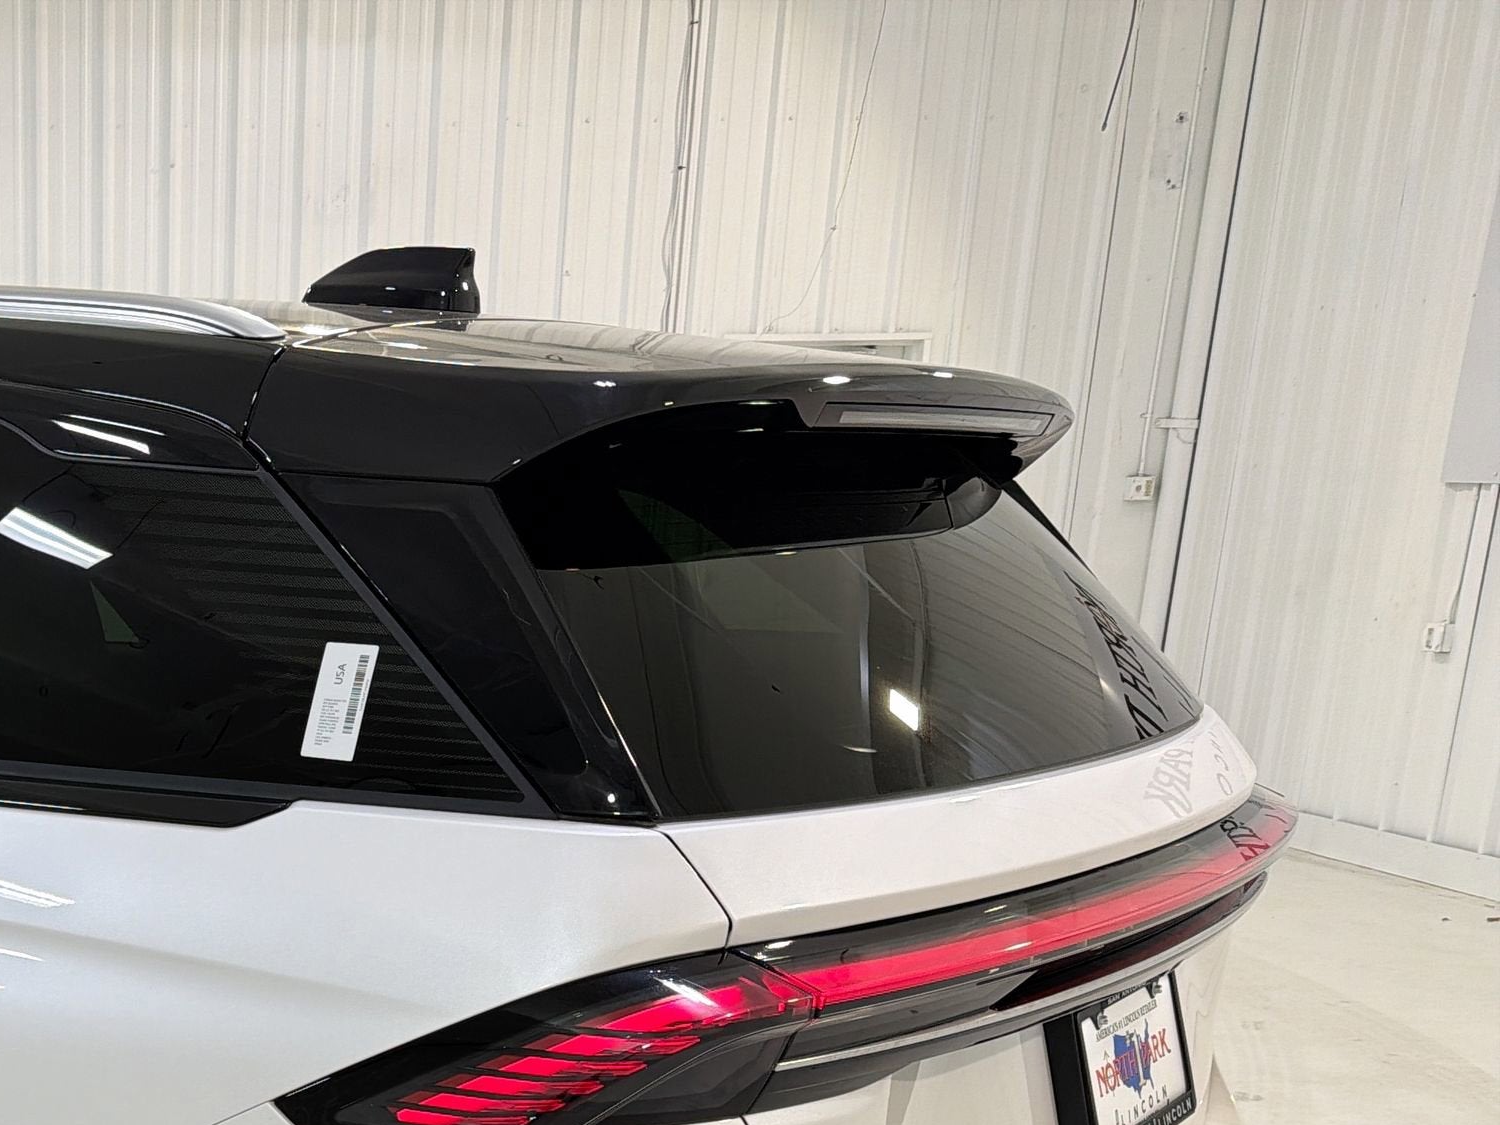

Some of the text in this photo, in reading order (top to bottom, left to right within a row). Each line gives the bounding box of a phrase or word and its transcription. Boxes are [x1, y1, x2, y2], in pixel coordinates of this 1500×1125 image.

[333, 663, 348, 685] USA
[1096, 1028, 1172, 1098] NORTH PARK
